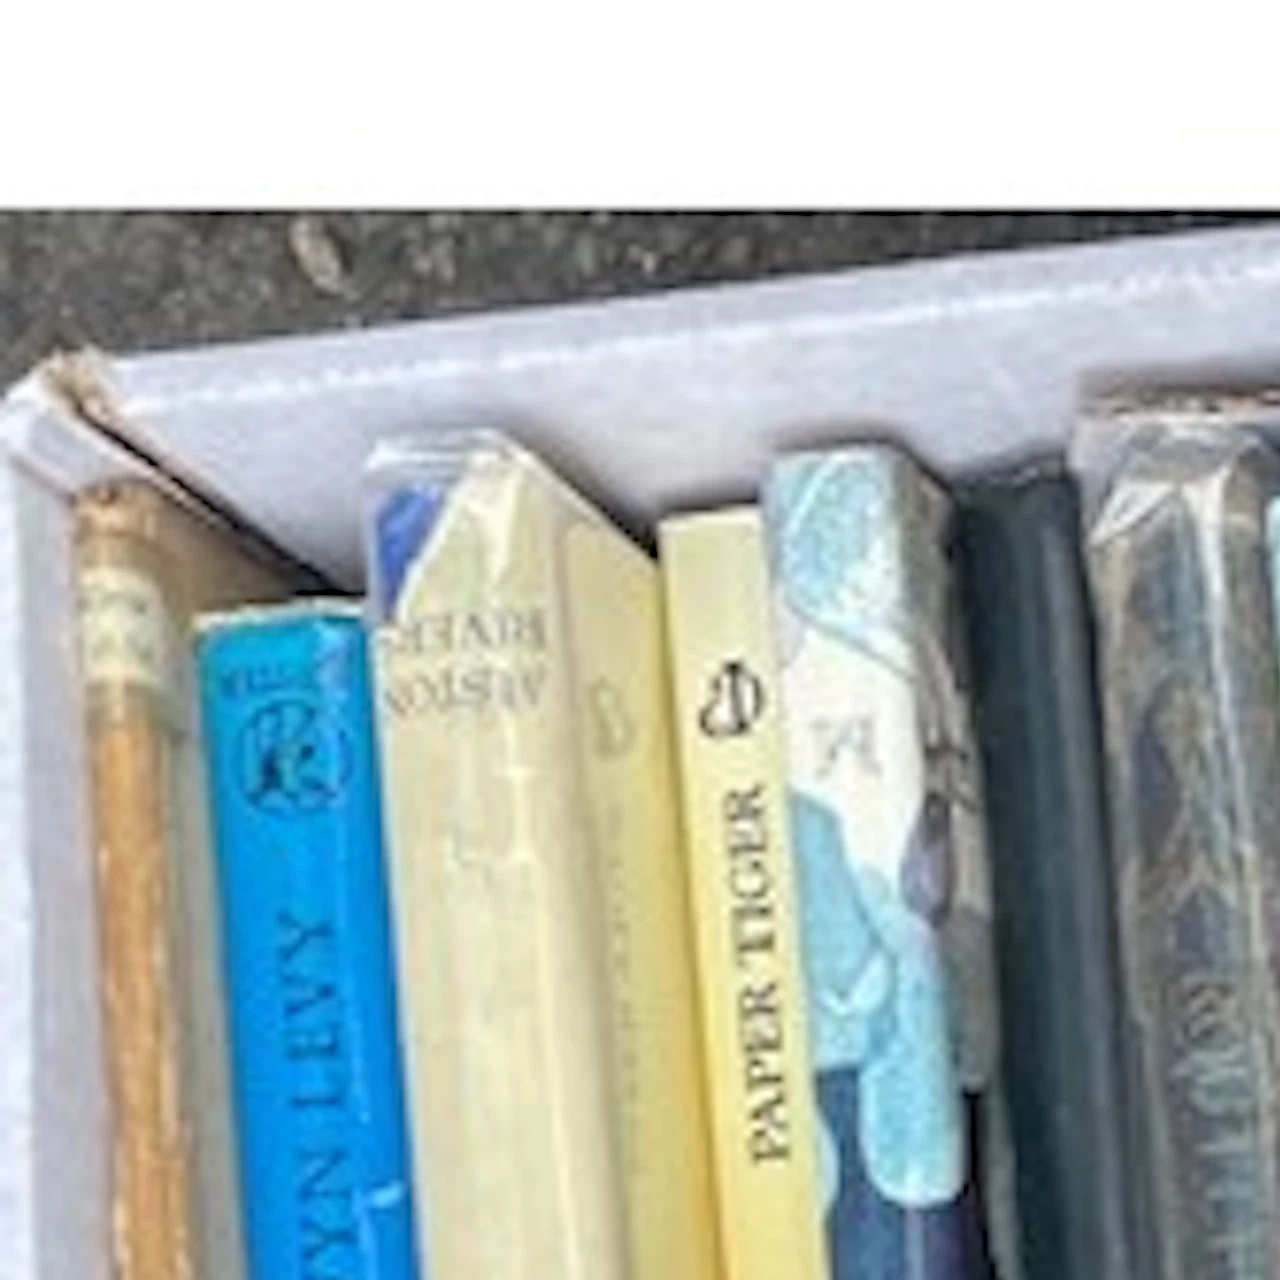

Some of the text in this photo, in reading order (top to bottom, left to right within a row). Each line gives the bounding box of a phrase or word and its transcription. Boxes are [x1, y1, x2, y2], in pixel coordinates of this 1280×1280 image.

[275, 910, 347, 1112] LEVY
[722, 780, 792, 1168] PAPER TIGER
